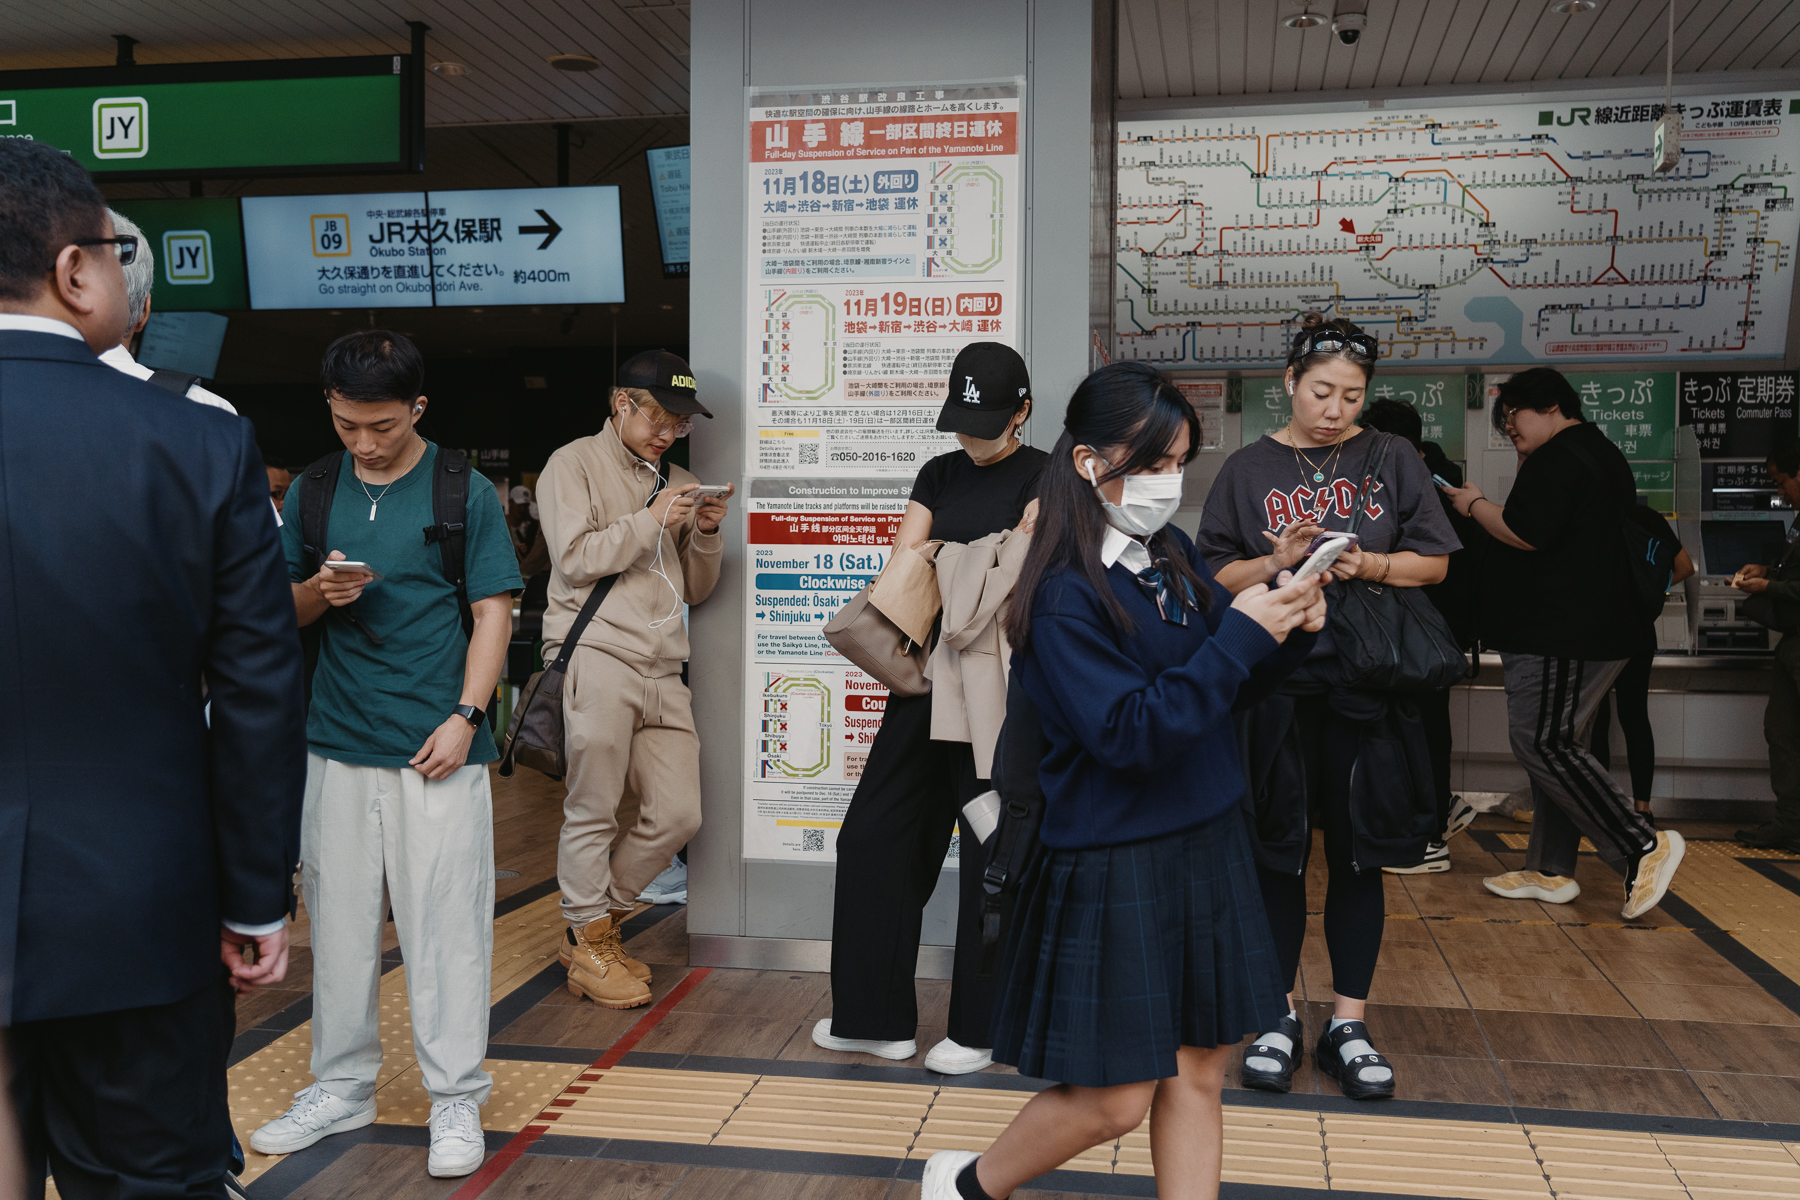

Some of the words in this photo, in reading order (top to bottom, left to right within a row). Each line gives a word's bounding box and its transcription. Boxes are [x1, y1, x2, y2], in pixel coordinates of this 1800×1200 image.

[821, 91, 944, 104] 渋谷駅改良工事
[765, 102, 1004, 118] 快適な駅空間の確保に向け、山手線の線路とホームを高くします。
[1556, 107, 1591, 126] JR
[106, 116, 135, 140] JY
[765, 121, 864, 149] 山手線
[870, 119, 1003, 141] 一部区間終日運休
[765, 150, 797, 159] Full-day
[798, 148, 844, 159] Suspension
[846, 148, 854, 156] of
[856, 147, 886, 156] Service
[900, 146, 916, 155] Part
[918, 145, 927, 154] of
[929, 145, 941, 153] the
[943, 144, 984, 153] Yamanote
[986, 143, 1003, 152] Line
[763, 170, 869, 196] 11月18日（土）
[877, 174, 915, 190] 外回り
[763, 201, 787, 213] 大崎
[797, 200, 821, 213] 渋谷
[832, 199, 855, 212] 新宿
[866, 198, 890, 211] 池袋
[894, 197, 918, 210] 運休
[324, 220, 338, 232] JB
[369, 217, 503, 245] JR大久保駅
[321, 233, 342, 250] 09
[176, 246, 201, 269] JY
[369, 245, 405, 257] Ōkubo
[408, 245, 447, 256] Staton
[317, 263, 506, 282] 大久保通りを直進してください。
[513, 269, 571, 285] 約400m
[319, 284, 336, 295] Go
[337, 283, 376, 297] straight
[379, 284, 394, 294] on
[396, 281, 455, 294] Okubodōri
[459, 281, 483, 292] Ave.
[844, 291, 952, 317] 11月19日（日）
[959, 296, 998, 313] 内回り
[844, 321, 868, 334] 池袋
[878, 320, 902, 333] 新宿
[913, 320, 938, 333] 渋谷
[948, 319, 973, 332] 大崎
[977, 319, 1002, 332] 運休
[963, 375, 980, 404] LA
[1374, 381, 1444, 407] きっぷ
[1581, 378, 1654, 405] きっぷ
[1684, 376, 1731, 404] きっぷ
[1737, 375, 1795, 404] 定期券
[1589, 409, 1644, 420] Tickets
[1691, 407, 1725, 419] Tickets
[1736, 406, 1773, 419] Commuter
[1774, 406, 1792, 418] Pass
[1624, 424, 1652, 437] 車票
[1709, 423, 1726, 434] 車票
[840, 452, 916, 462] 050-2016-1620
[1717, 477, 1778, 486] きっぷ・チャー
[788, 486, 848, 495] Construction
[850, 486, 859, 495] to
[861, 486, 899, 496] Improve
[766, 502, 792, 510] Yamanote
[793, 502, 804, 510] Line
[805, 502, 822, 510] tracks
[823, 502, 833, 510] and
[833, 502, 859, 511] platforms
[860, 502, 871, 510] will
[771, 515, 798, 523] Full-day
[799, 515, 840, 523] Suspension
[789, 523, 821, 533] 山手线
[822, 525, 876, 534] 部分区间全天停运
[833, 533, 875, 544] 야마노테선
[756, 558, 809, 569] November
[814, 554, 833, 569] 18
[840, 552, 883, 572] (Sat.)
[799, 575, 866, 590] Clockwise
[755, 594, 810, 608] Suspended:
[813, 592, 839, 607] Ōsaki
[769, 610, 811, 624] Shinjuku
